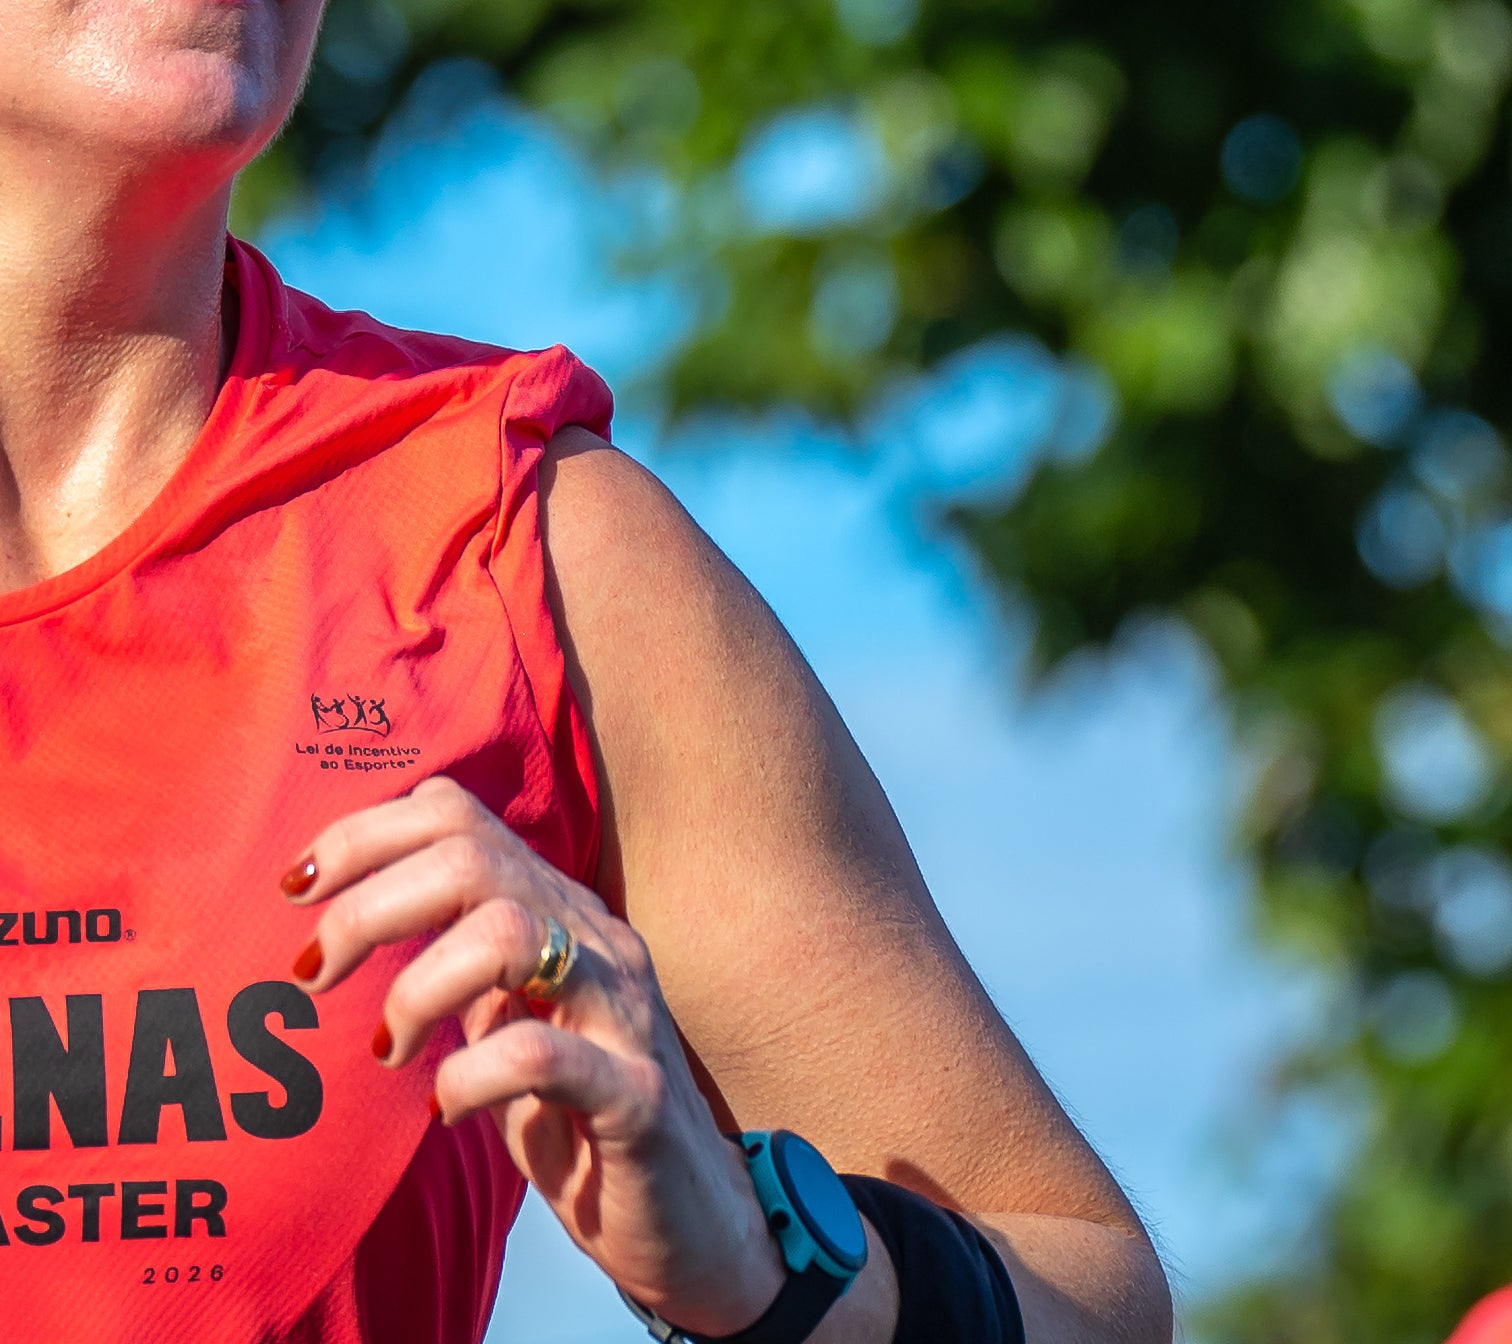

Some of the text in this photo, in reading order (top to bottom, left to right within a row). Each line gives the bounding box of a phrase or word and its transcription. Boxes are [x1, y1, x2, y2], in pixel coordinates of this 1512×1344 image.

[296, 743, 421, 757] Lei de Incentivo
[320, 759, 406, 773] ao Esporte
[142, 1264, 226, 1285] 2026
